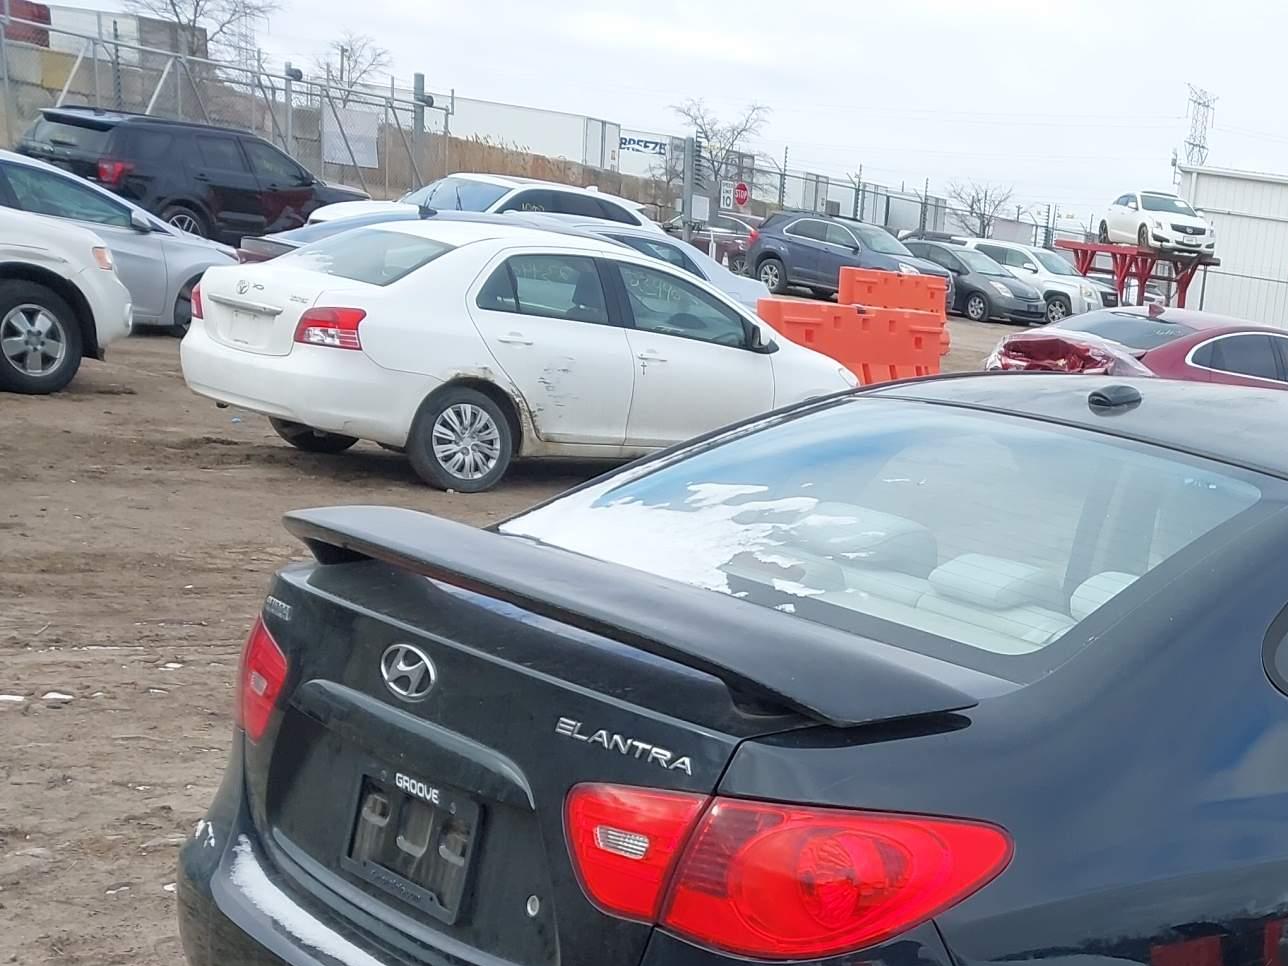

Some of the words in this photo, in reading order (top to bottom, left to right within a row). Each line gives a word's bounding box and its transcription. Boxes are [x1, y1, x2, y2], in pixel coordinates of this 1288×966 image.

[619, 137, 667, 155] BREEZE
[722, 195, 731, 207] 10
[735, 189, 748, 199] STOP
[555, 717, 692, 776] ELANTRA
[395, 772, 440, 804] GROOVE
